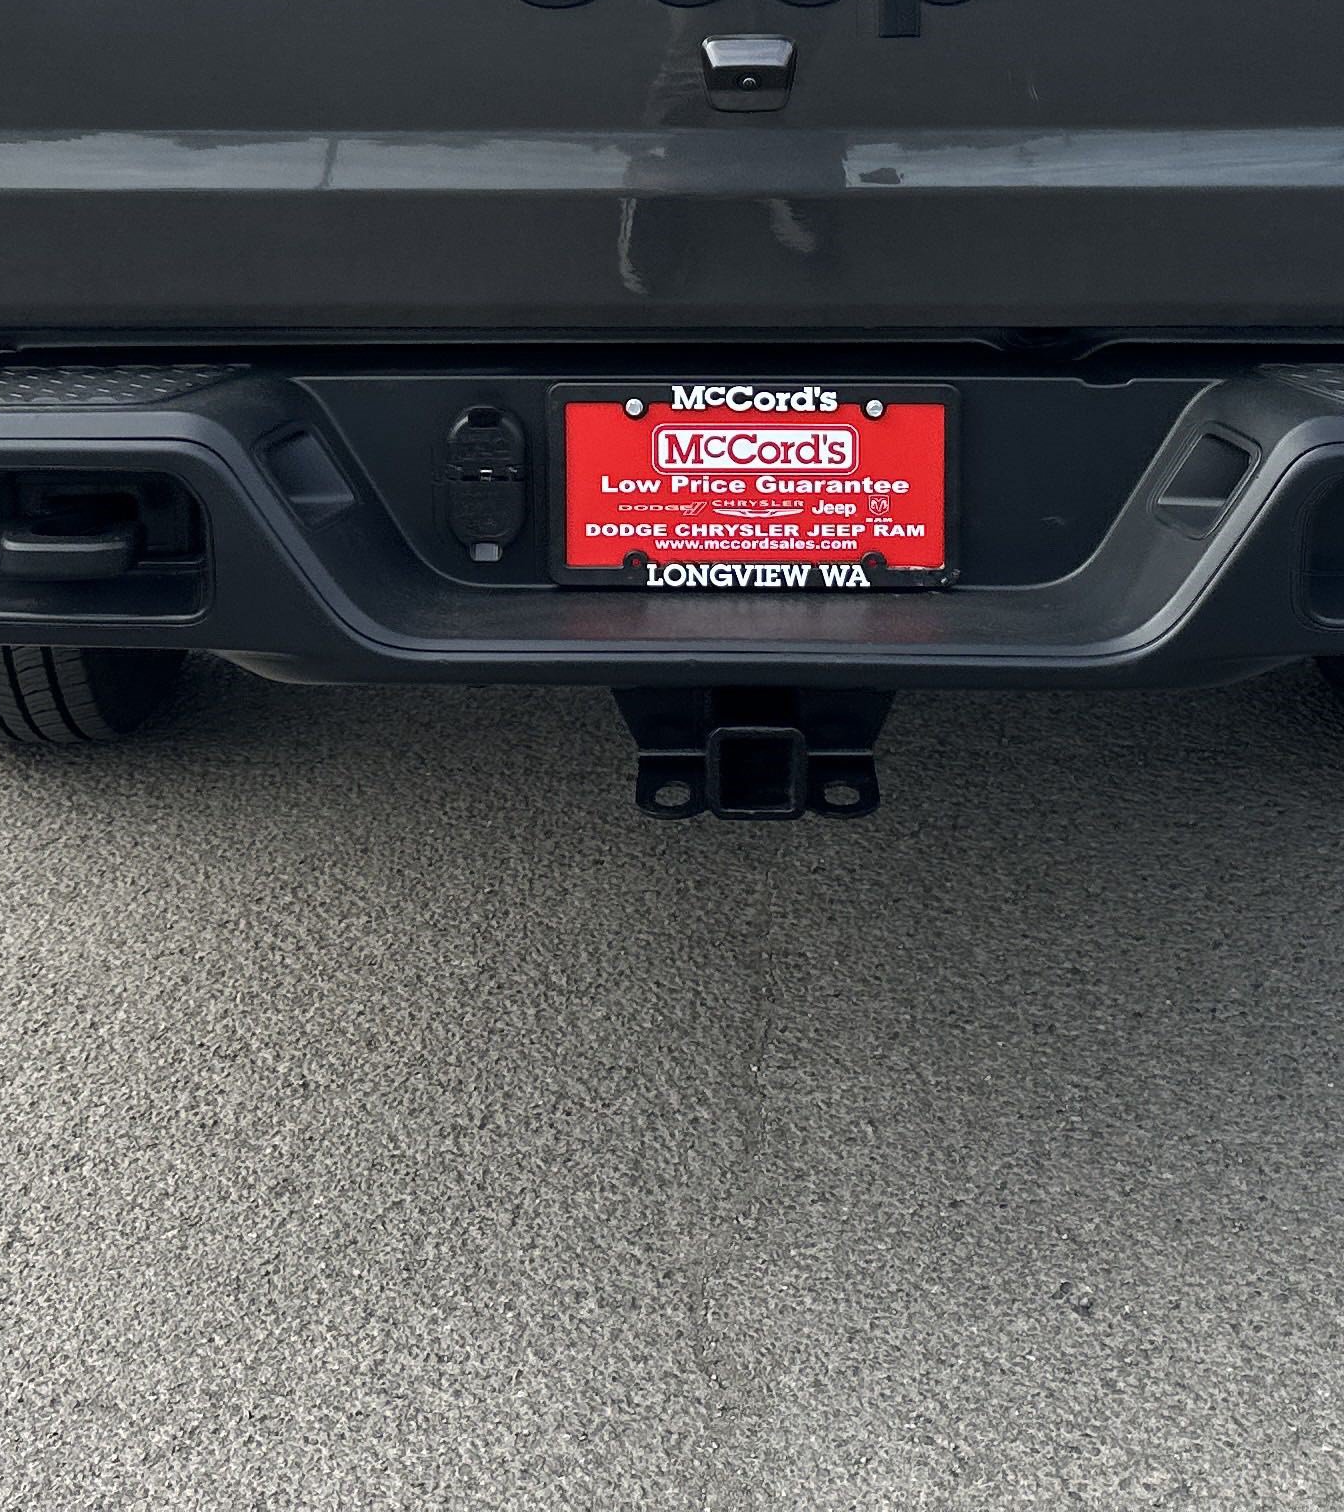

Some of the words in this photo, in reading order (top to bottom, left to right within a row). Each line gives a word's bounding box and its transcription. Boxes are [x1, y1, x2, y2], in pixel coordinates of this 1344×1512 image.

[671, 385, 838, 412] McCord's
[664, 433, 846, 465] McCord's
[601, 475, 662, 494] Low
[671, 475, 746, 494] Price
[755, 475, 910, 494] Guarantee
[711, 498, 805, 508] CHRYSLER
[811, 499, 858, 517] Jeep
[585, 523, 668, 537] DODGE
[674, 523, 800, 537] CHRYSLER
[807, 523, 867, 537] JEEP
[873, 523, 926, 537] RAM
[654, 538, 858, 551] www.mccordsales.com
[646, 563, 812, 587] LONGVIEW
[818, 563, 871, 587] WA
